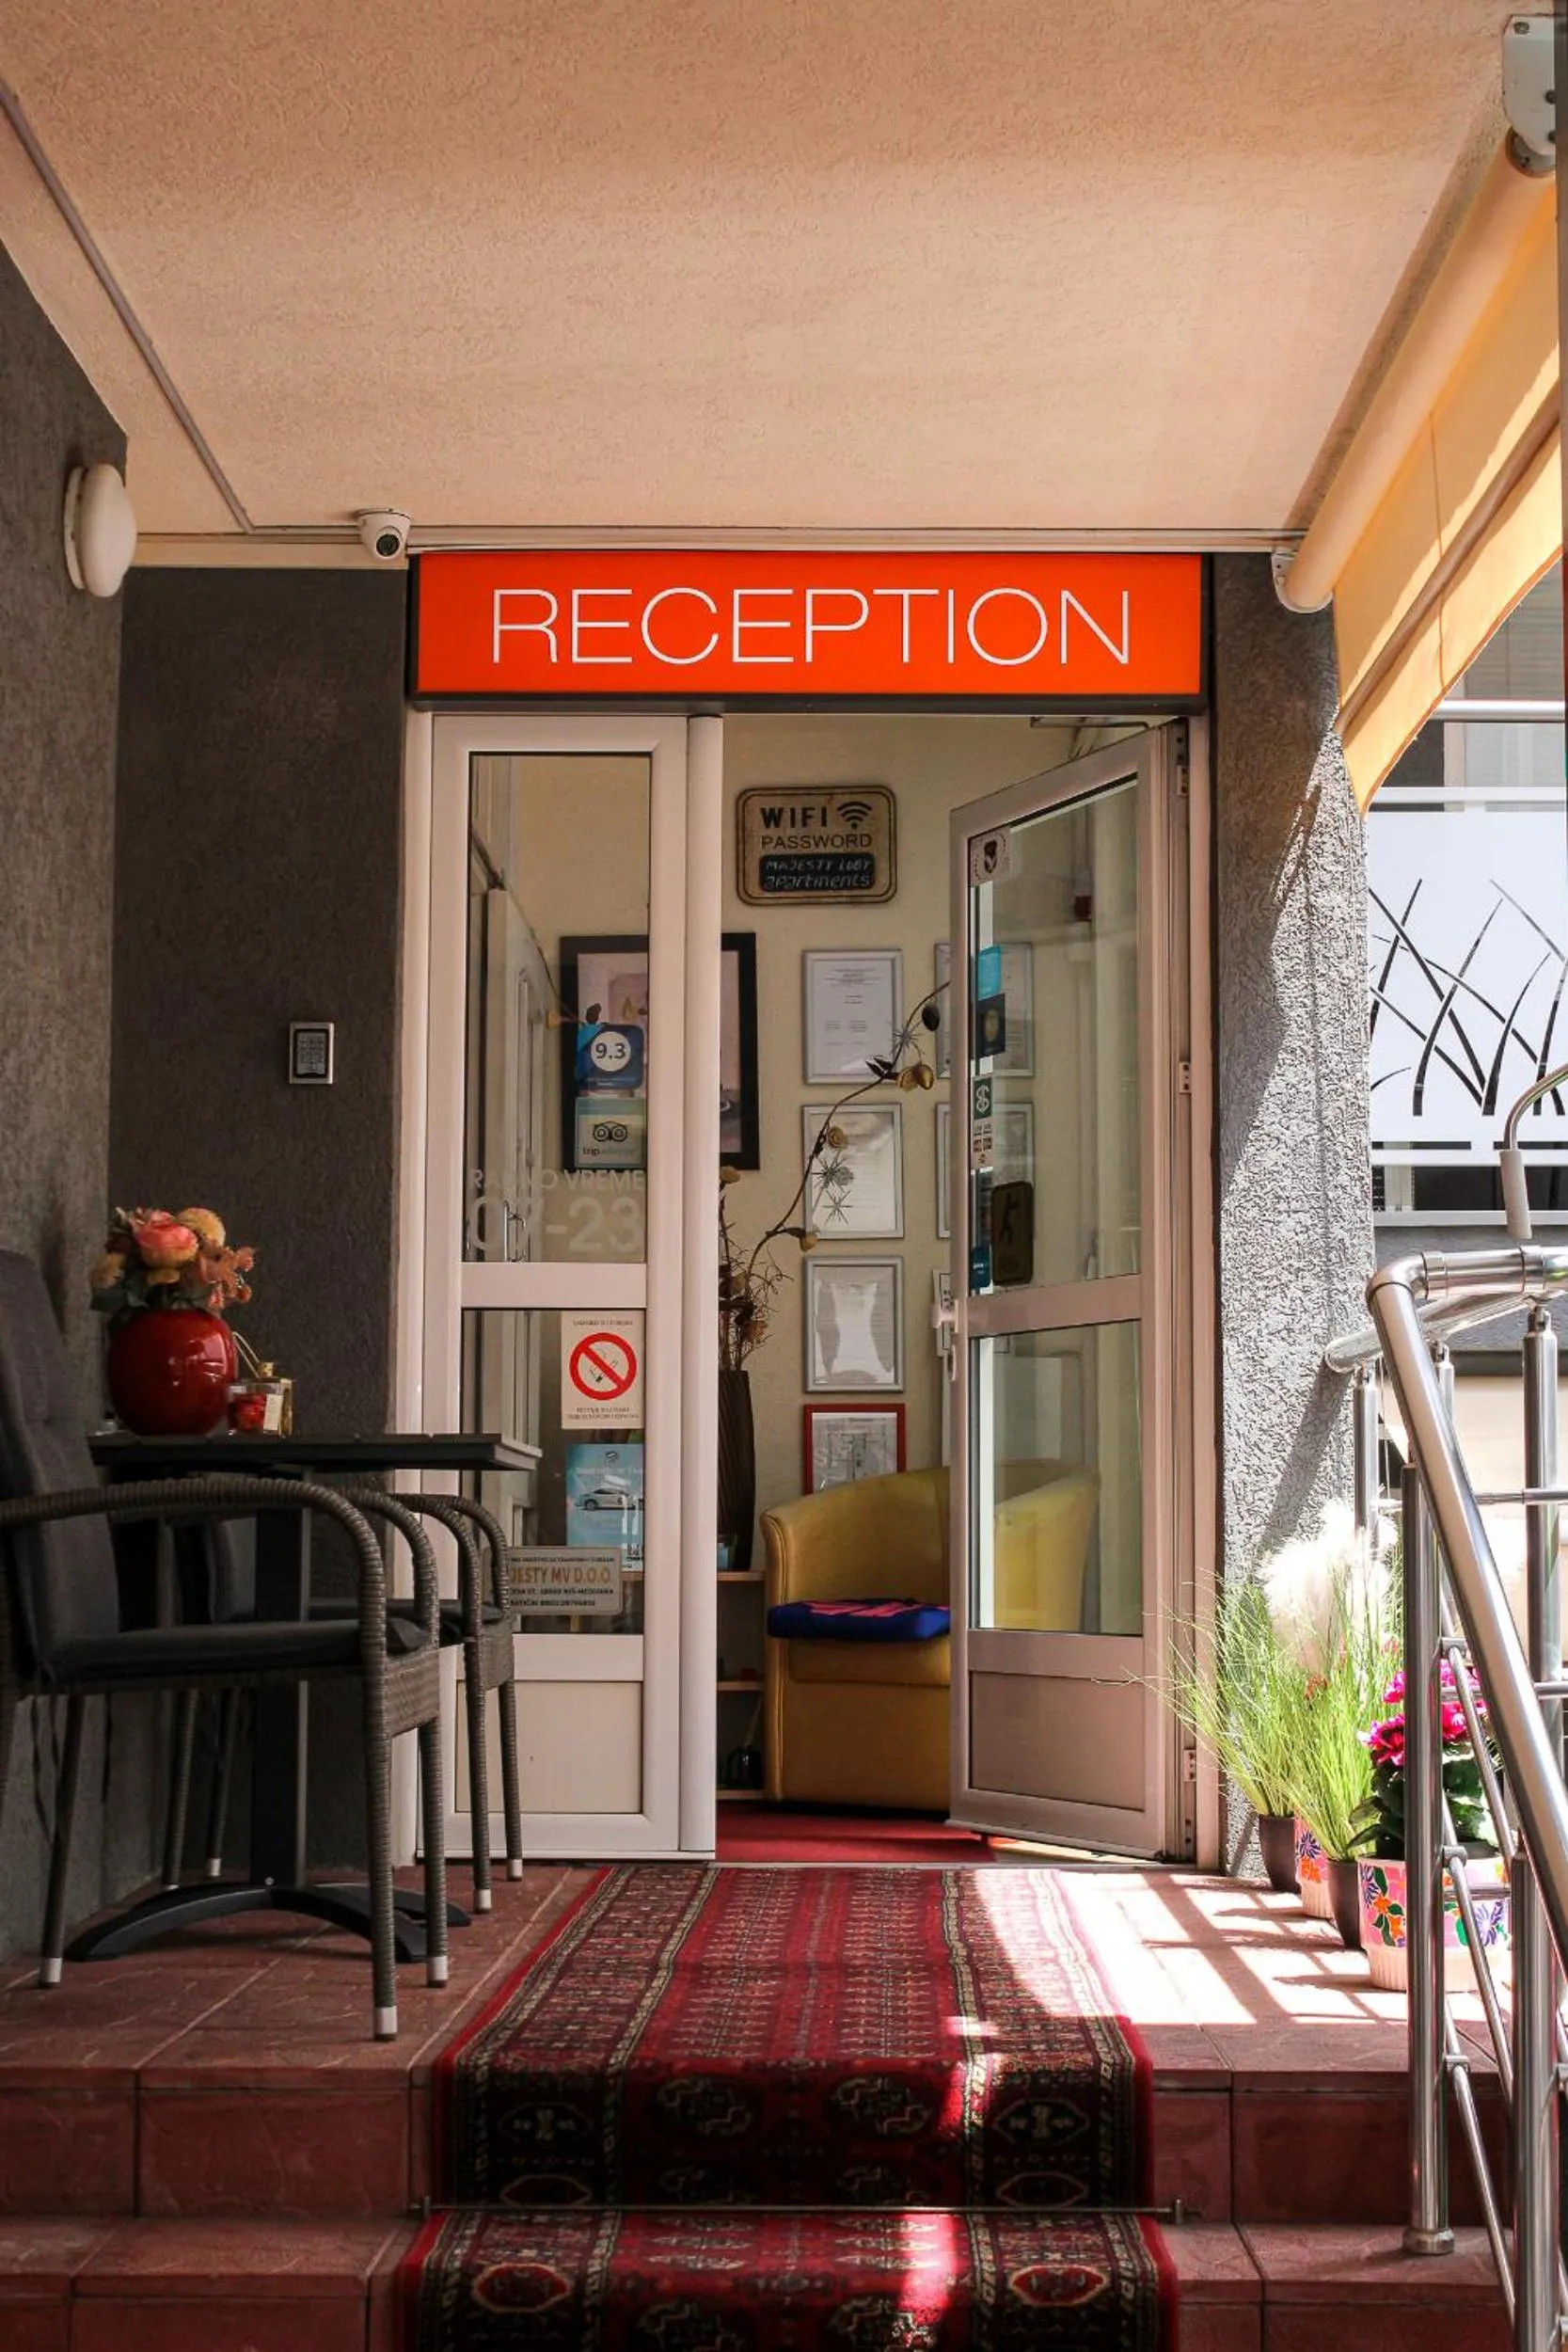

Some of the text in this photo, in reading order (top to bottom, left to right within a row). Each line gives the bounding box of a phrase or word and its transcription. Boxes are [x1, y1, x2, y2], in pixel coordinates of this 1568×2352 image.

[492, 587, 1130, 665] RECEPTION
[759, 805, 828, 829] WIFI
[761, 834, 873, 850] PASSWORD
[595, 1042, 626, 1059] 9.3
[564, 1169, 645, 1192] VREME
[551, 1567, 570, 1584] MV
